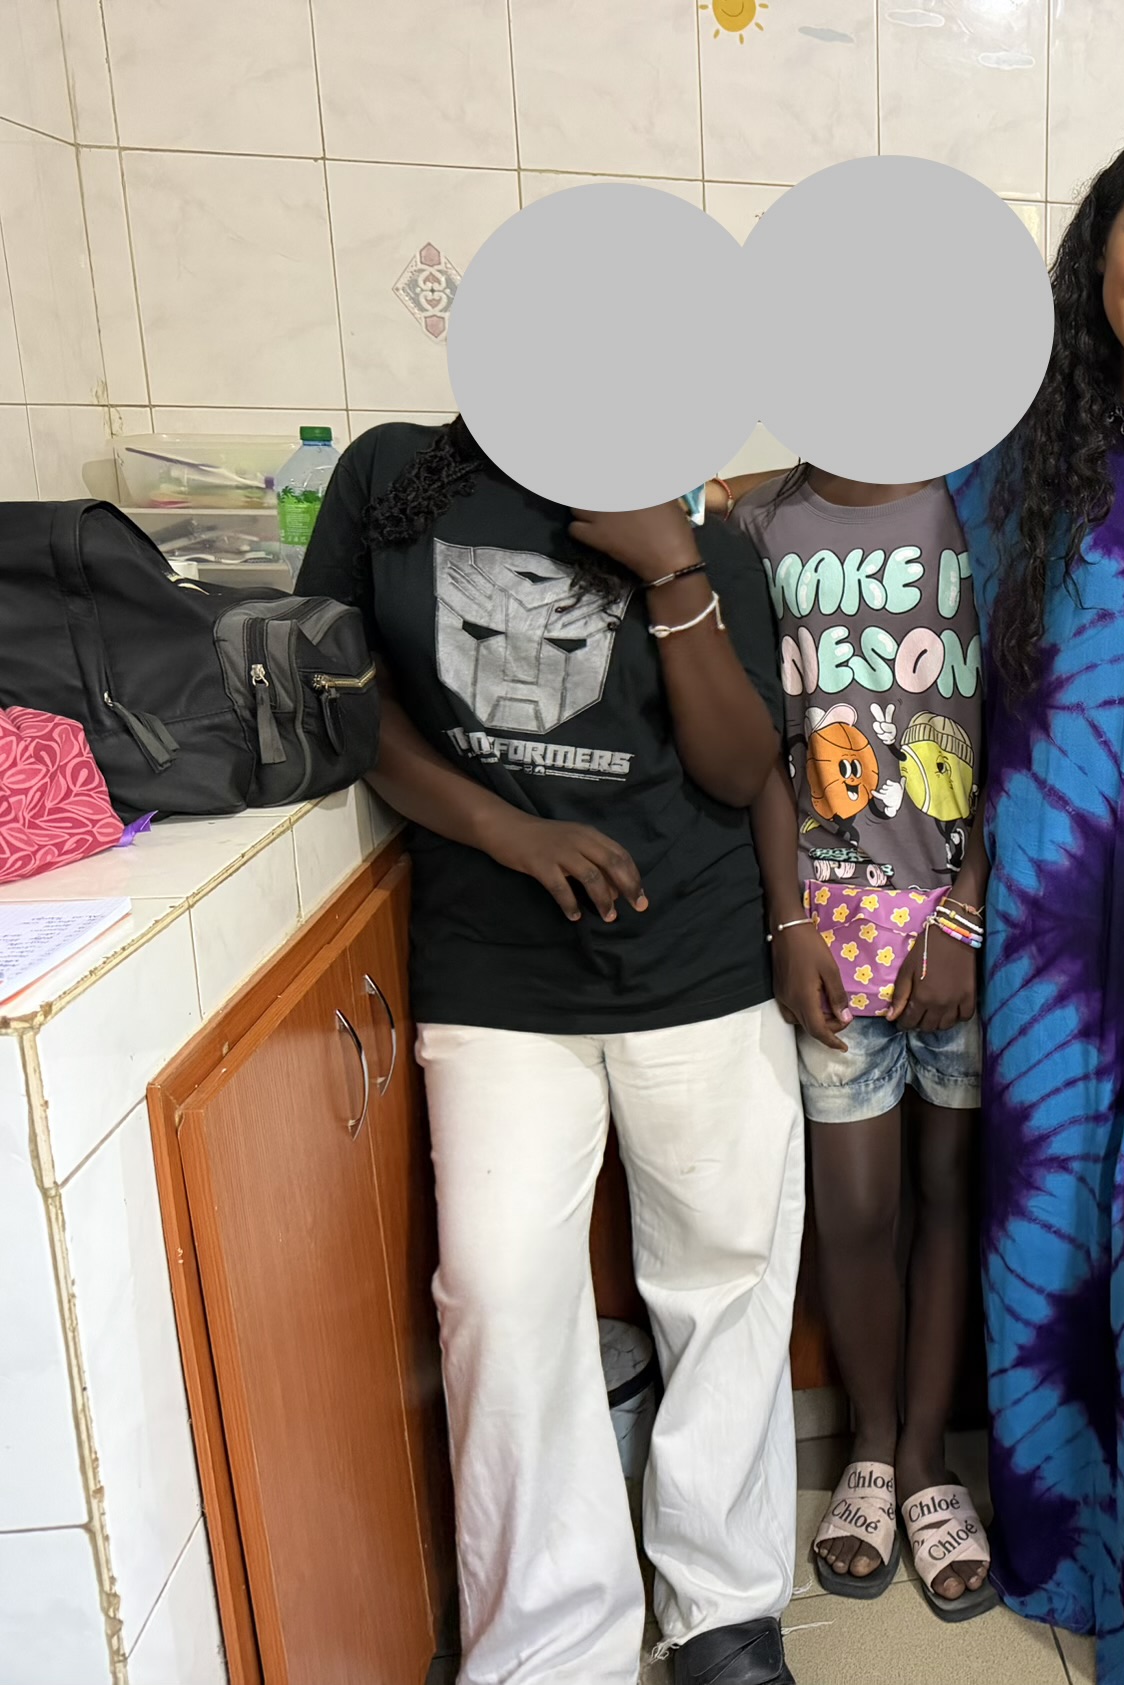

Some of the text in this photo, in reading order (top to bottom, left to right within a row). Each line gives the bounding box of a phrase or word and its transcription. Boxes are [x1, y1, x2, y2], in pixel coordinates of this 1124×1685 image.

[847, 1470, 894, 1492] Chloé
[832, 1499, 881, 1534] Chloé
[909, 1495, 961, 1523] Chloé
[929, 1520, 978, 1561] Chloé
